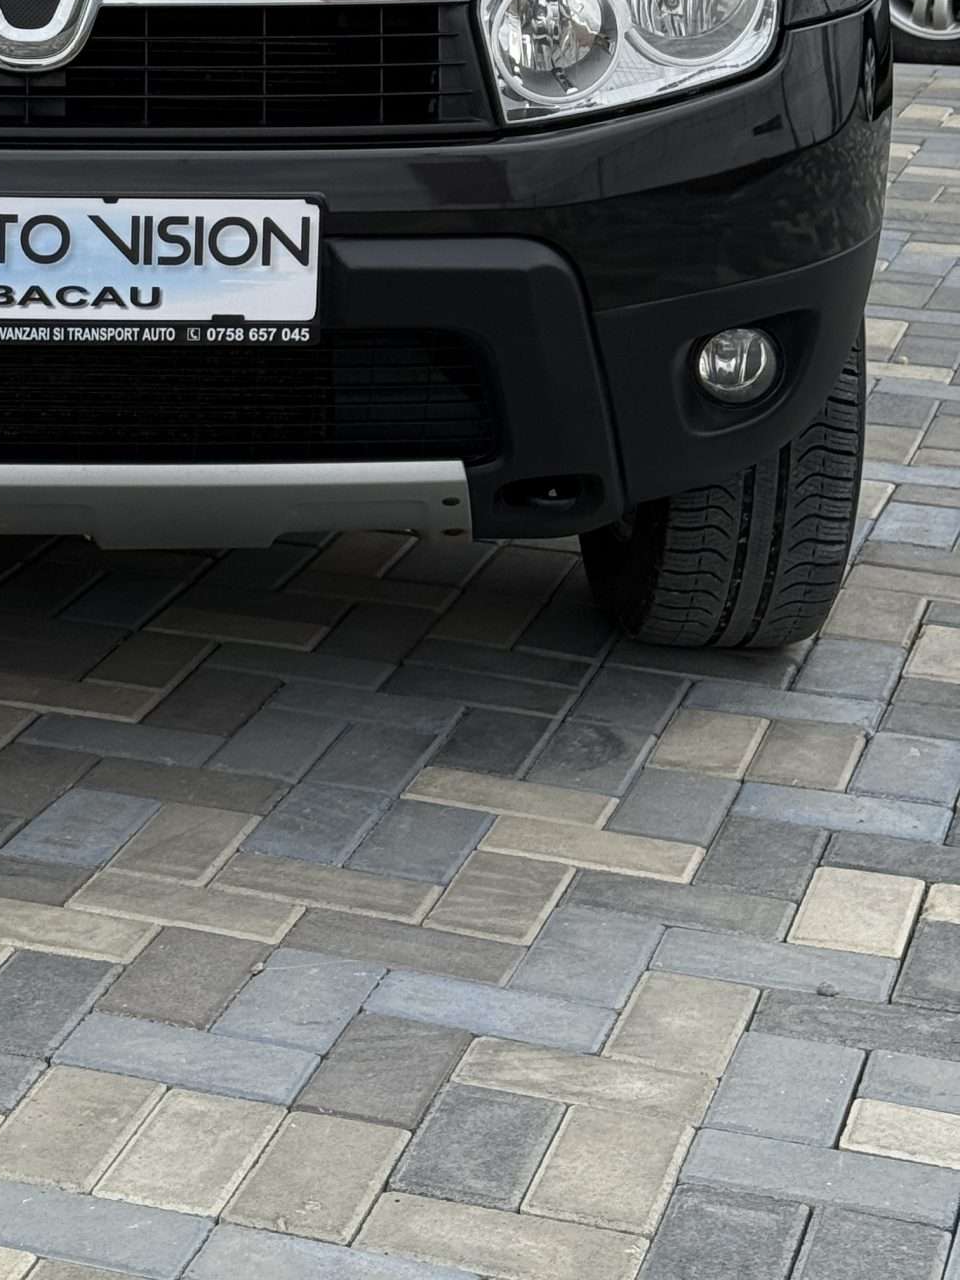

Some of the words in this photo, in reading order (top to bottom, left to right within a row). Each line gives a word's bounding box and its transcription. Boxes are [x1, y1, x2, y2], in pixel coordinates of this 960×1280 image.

[88, 215, 311, 267] VISION
[52, 327, 64, 341] SI
[66, 327, 140, 342] TRANSPORT
[142, 327, 176, 342] AUTO
[206, 327, 244, 341] 0758
[248, 327, 277, 342] 657
[281, 327, 310, 342] 045
